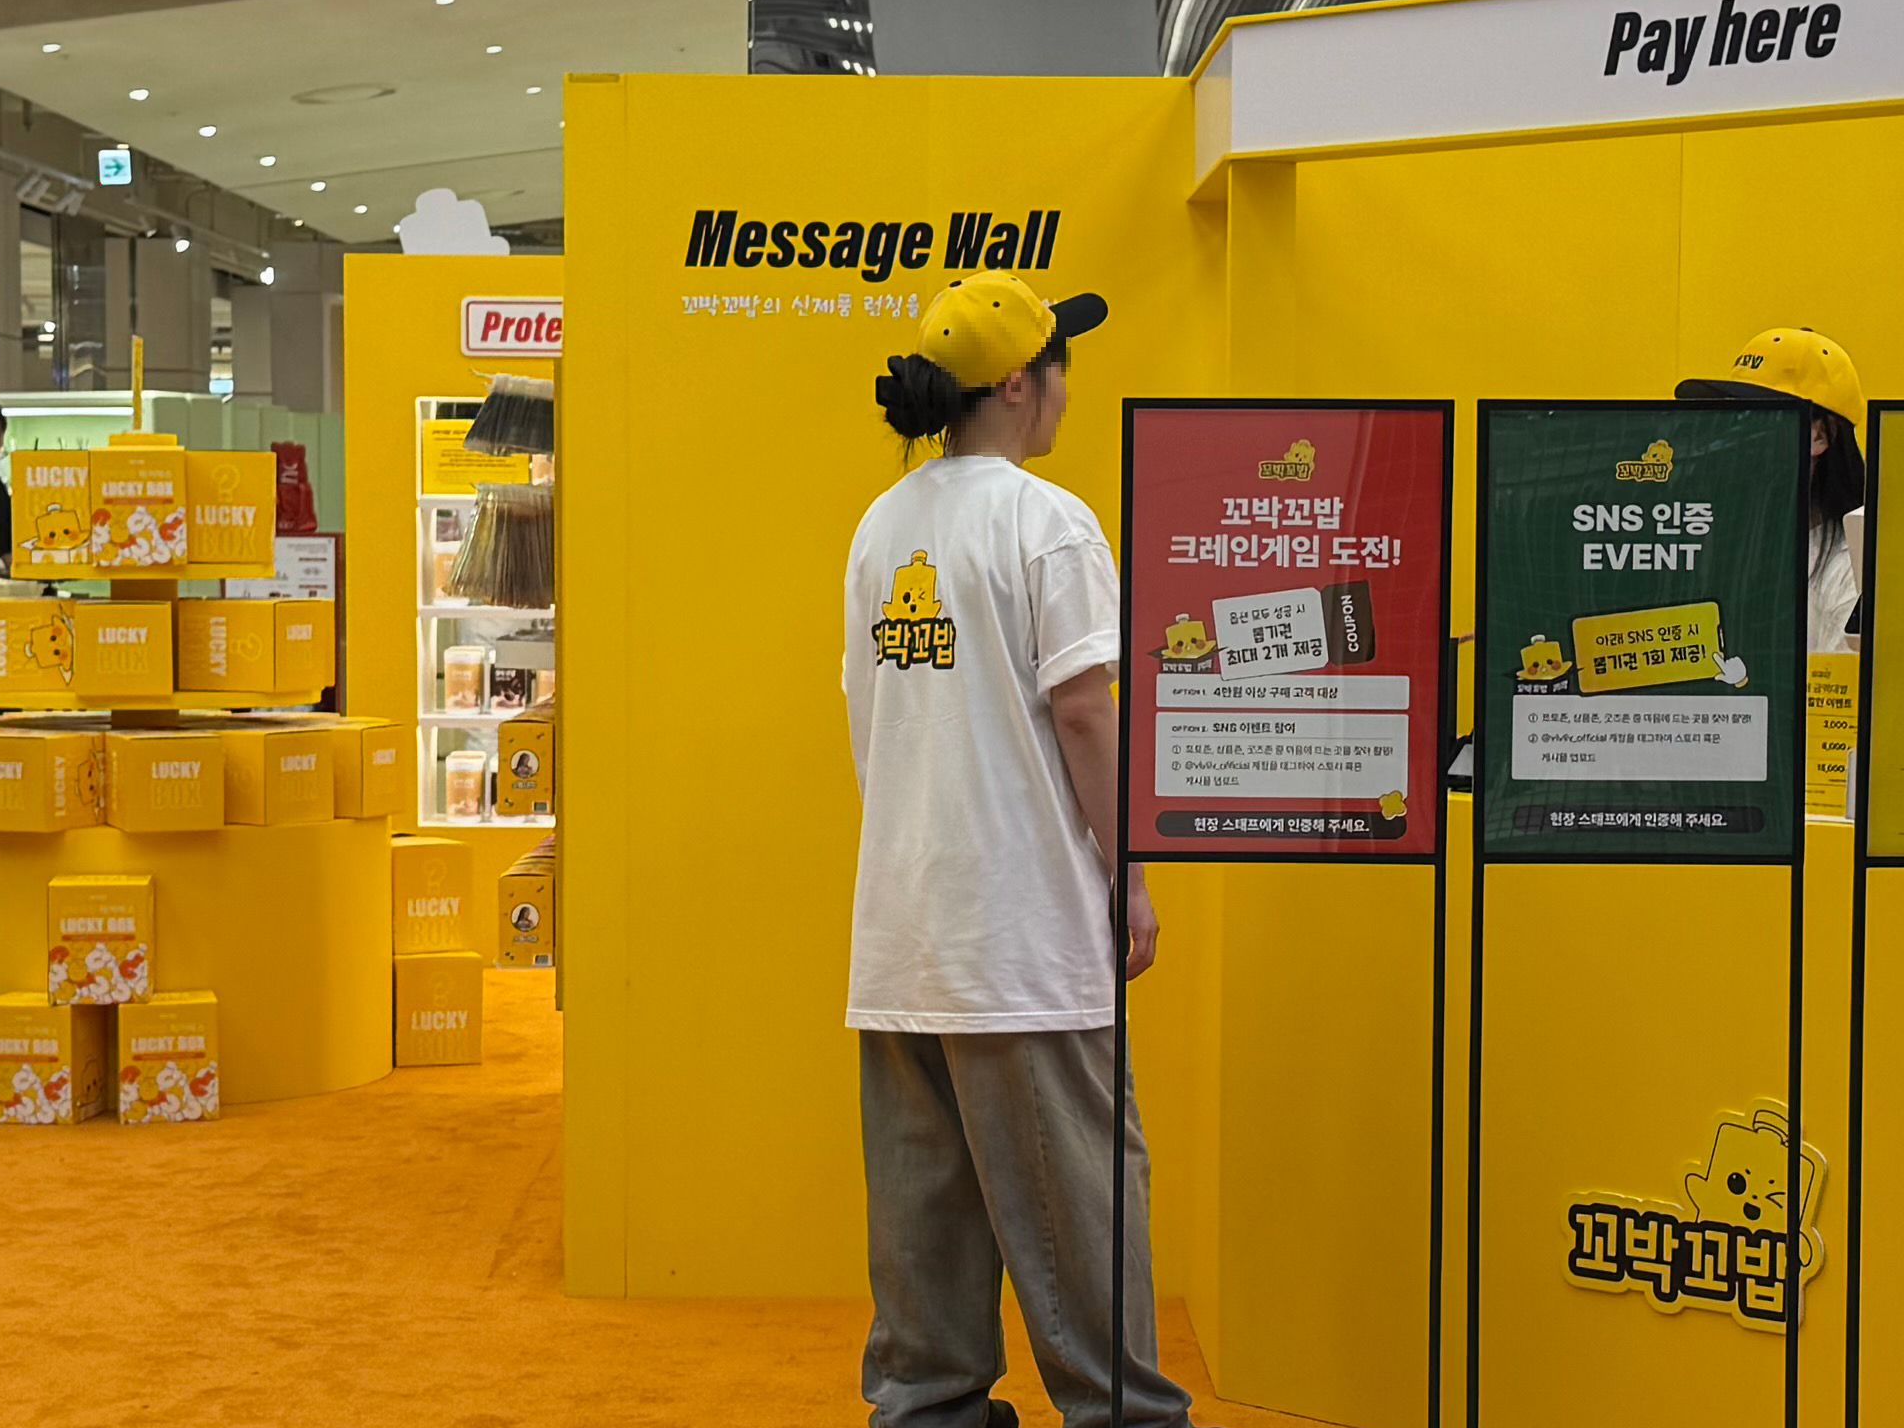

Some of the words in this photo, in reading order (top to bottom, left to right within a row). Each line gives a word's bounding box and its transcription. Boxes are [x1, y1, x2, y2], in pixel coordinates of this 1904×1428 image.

[1604, 10, 1705, 85] Pay
[685, 209, 934, 284] Message
[943, 210, 1061, 270] Wall
[26, 466, 88, 489] LUCKY
[101, 480, 144, 498] LUCKY
[195, 505, 257, 527] LUCKY
[1220, 495, 1344, 530] 꼬박꼬밥
[1572, 503, 1644, 533] SNS
[1652, 500, 1715, 536] 인증
[1168, 534, 1321, 570] 크레인게임
[1328, 535, 1401, 570] 도전!
[1582, 543, 1703, 571] EVENT
[1296, 603, 1306, 615] 시
[1252, 622, 1293, 644] 뽑기권
[1340, 594, 1360, 653] COUPON
[1595, 634, 1624, 647] 아래
[1627, 629, 1654, 645] SNS
[1657, 625, 1683, 642] 인증
[1687, 623, 1699, 636] 시
[97, 627, 148, 645] LUCKY
[1226, 648, 1259, 666] 최대
[1263, 643, 1289, 661] 2개
[1293, 637, 1323, 658] 제공
[1642, 649, 1665, 666] 1회
[1670, 644, 1707, 664] 제공!
[151, 760, 202, 780] LUCKY
[407, 897, 461, 918] LUCKY
[411, 1010, 469, 1031] LUCKY
[1571, 1207, 1789, 1320] 꼬박꼬밥
